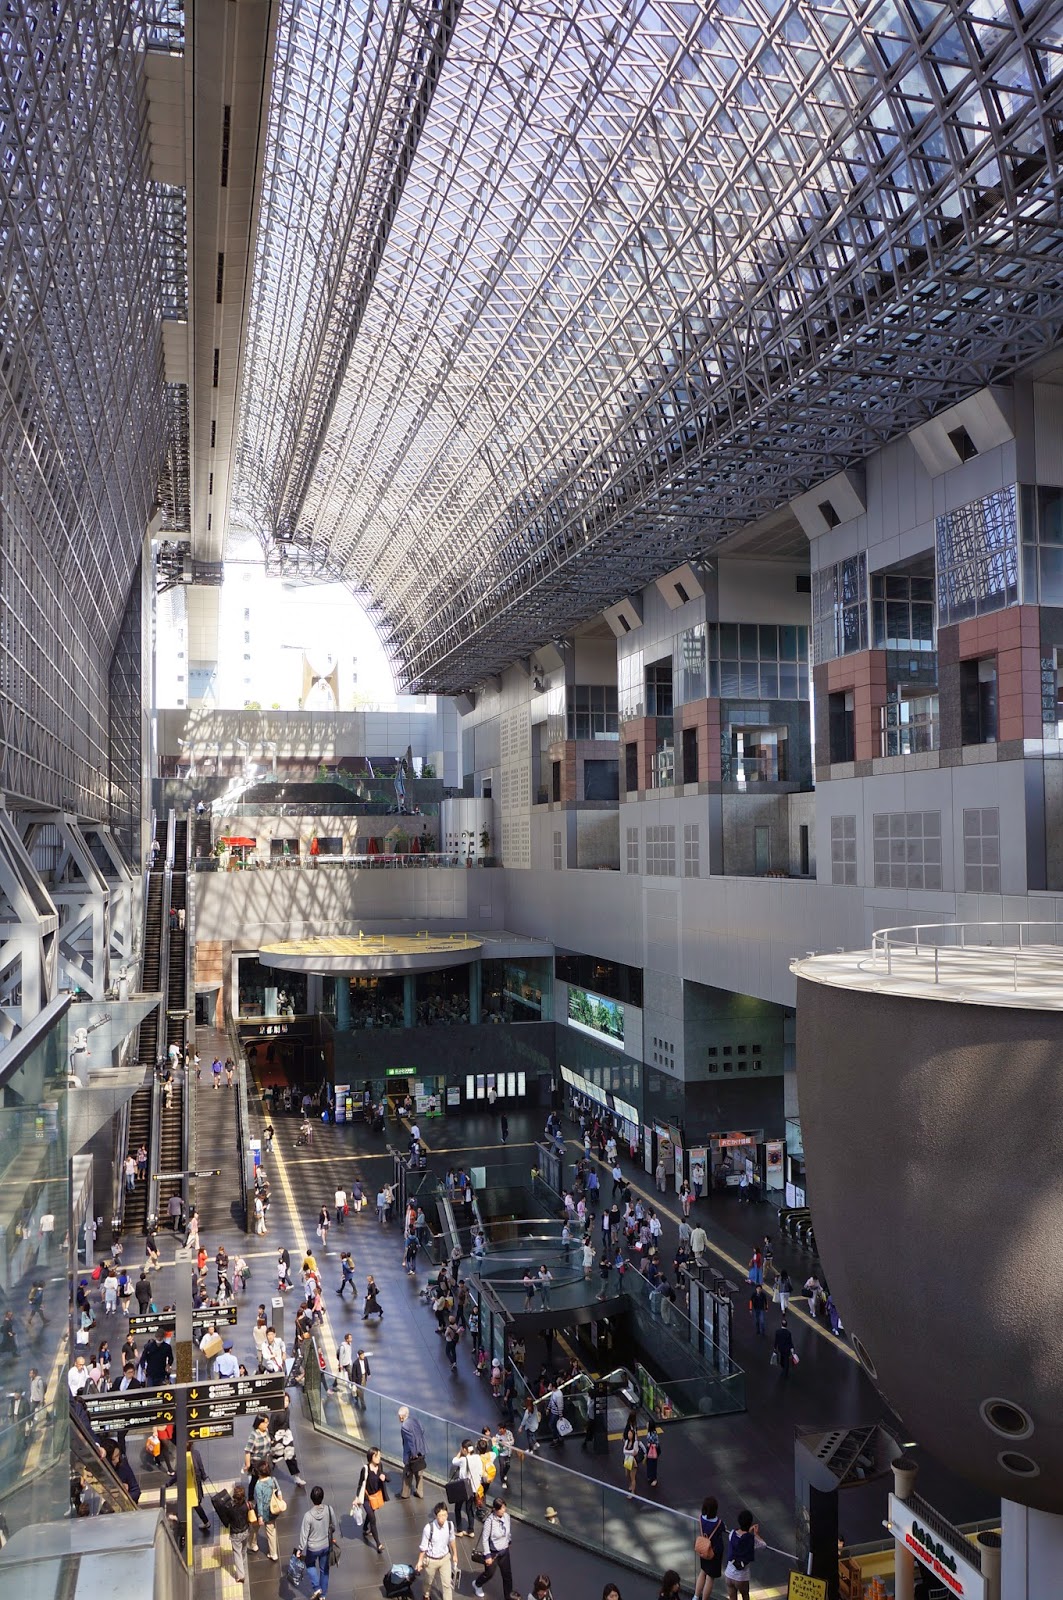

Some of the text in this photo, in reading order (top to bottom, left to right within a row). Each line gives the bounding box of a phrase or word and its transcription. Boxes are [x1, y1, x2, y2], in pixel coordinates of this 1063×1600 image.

[722, 1137, 751, 1146] おでかけ情報
[559, 1423, 570, 1432] GU
[794, 1575, 821, 1589] カフェオレの
